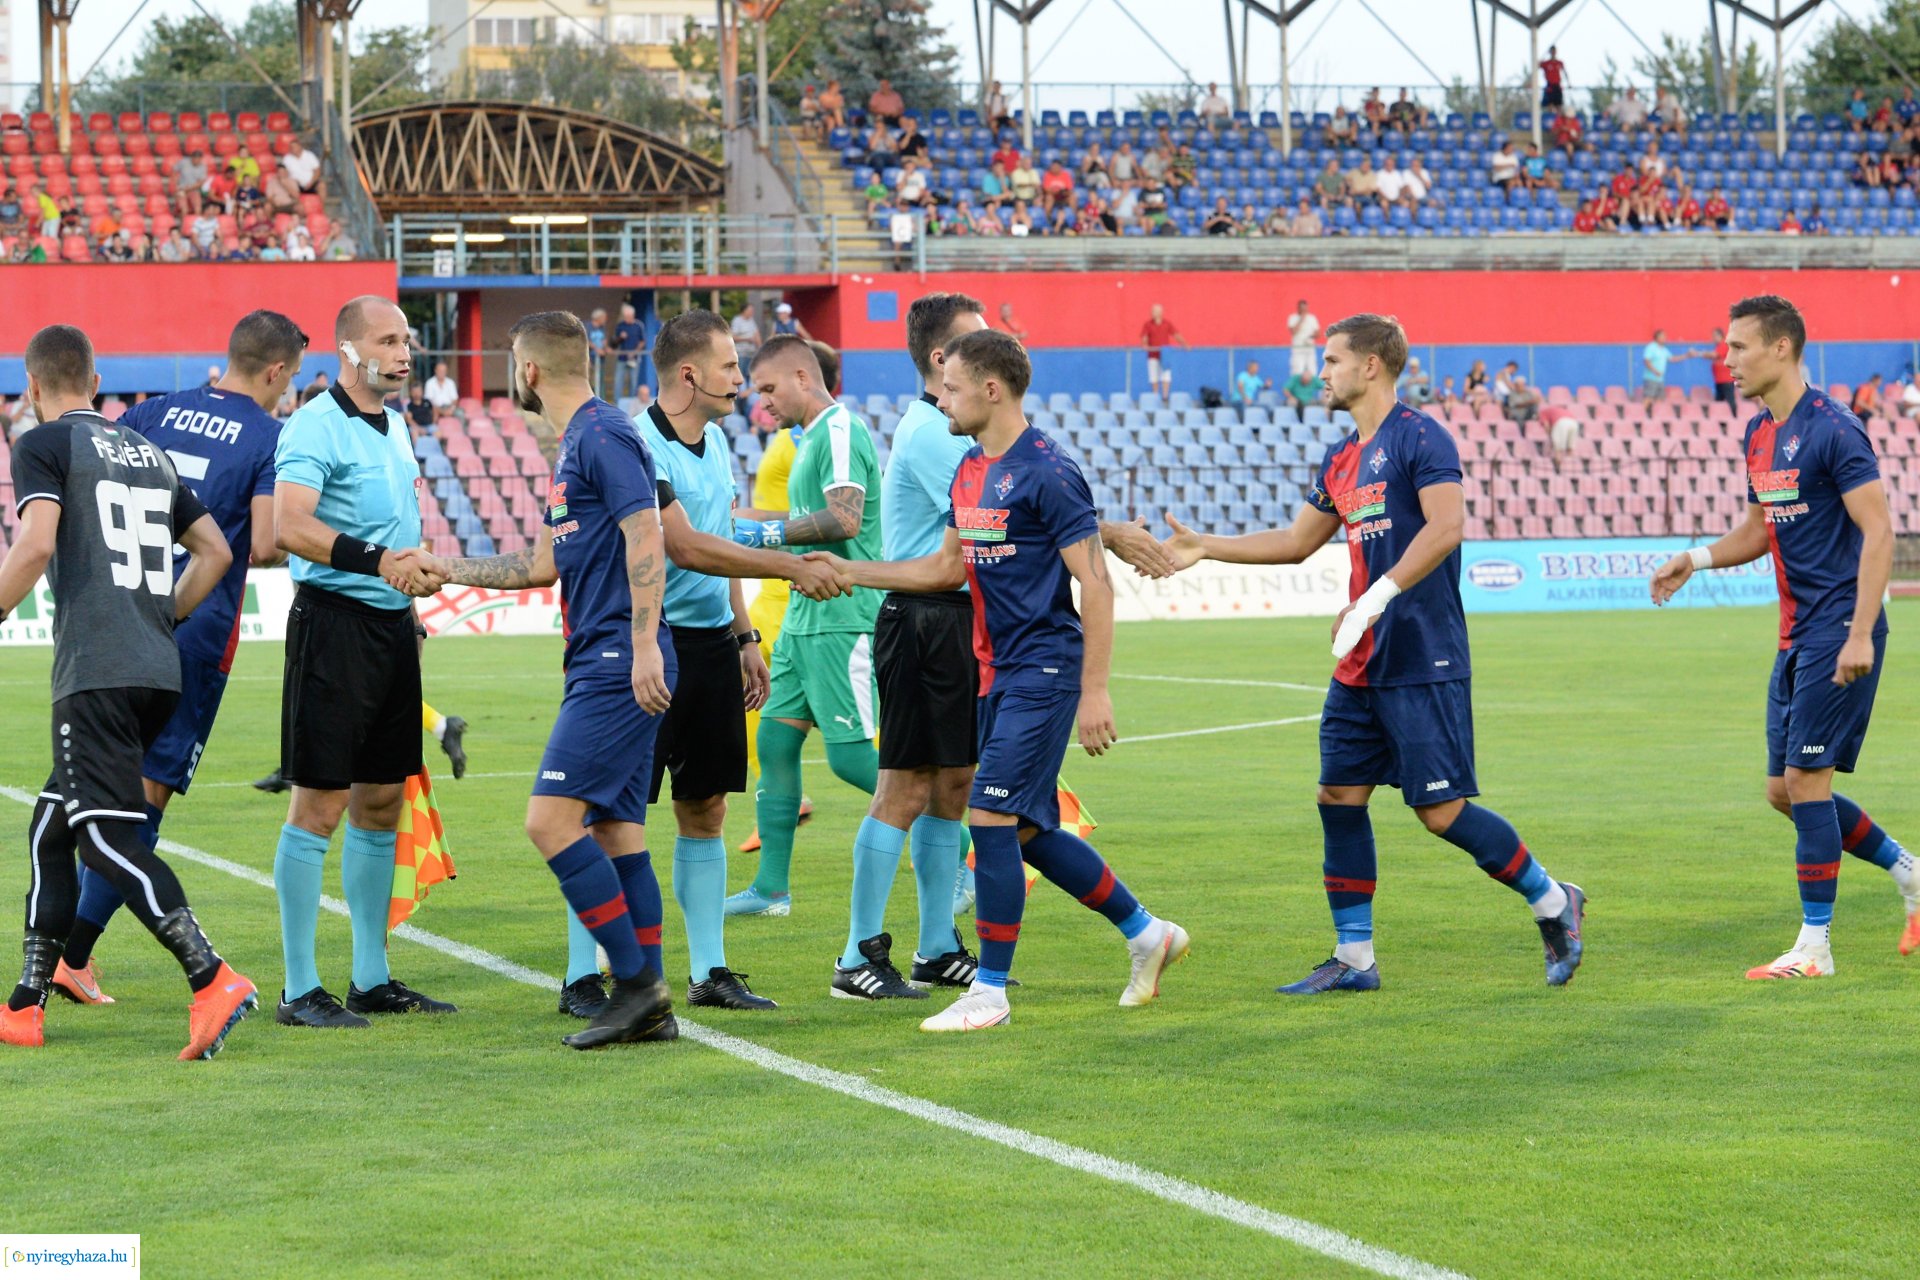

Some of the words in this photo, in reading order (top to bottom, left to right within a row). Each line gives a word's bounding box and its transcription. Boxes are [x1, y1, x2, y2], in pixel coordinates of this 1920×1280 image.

[160, 406, 243, 445] FODOR
[91, 436, 159, 467] FEJÉR
[95, 480, 173, 596] 95
[762, 520, 782, 547] GK
[1802, 745, 1825, 754] JAKO
[541, 770, 565, 780] JAKO
[984, 786, 1008, 797] JAKO
[1426, 780, 1449, 791] JAKO
